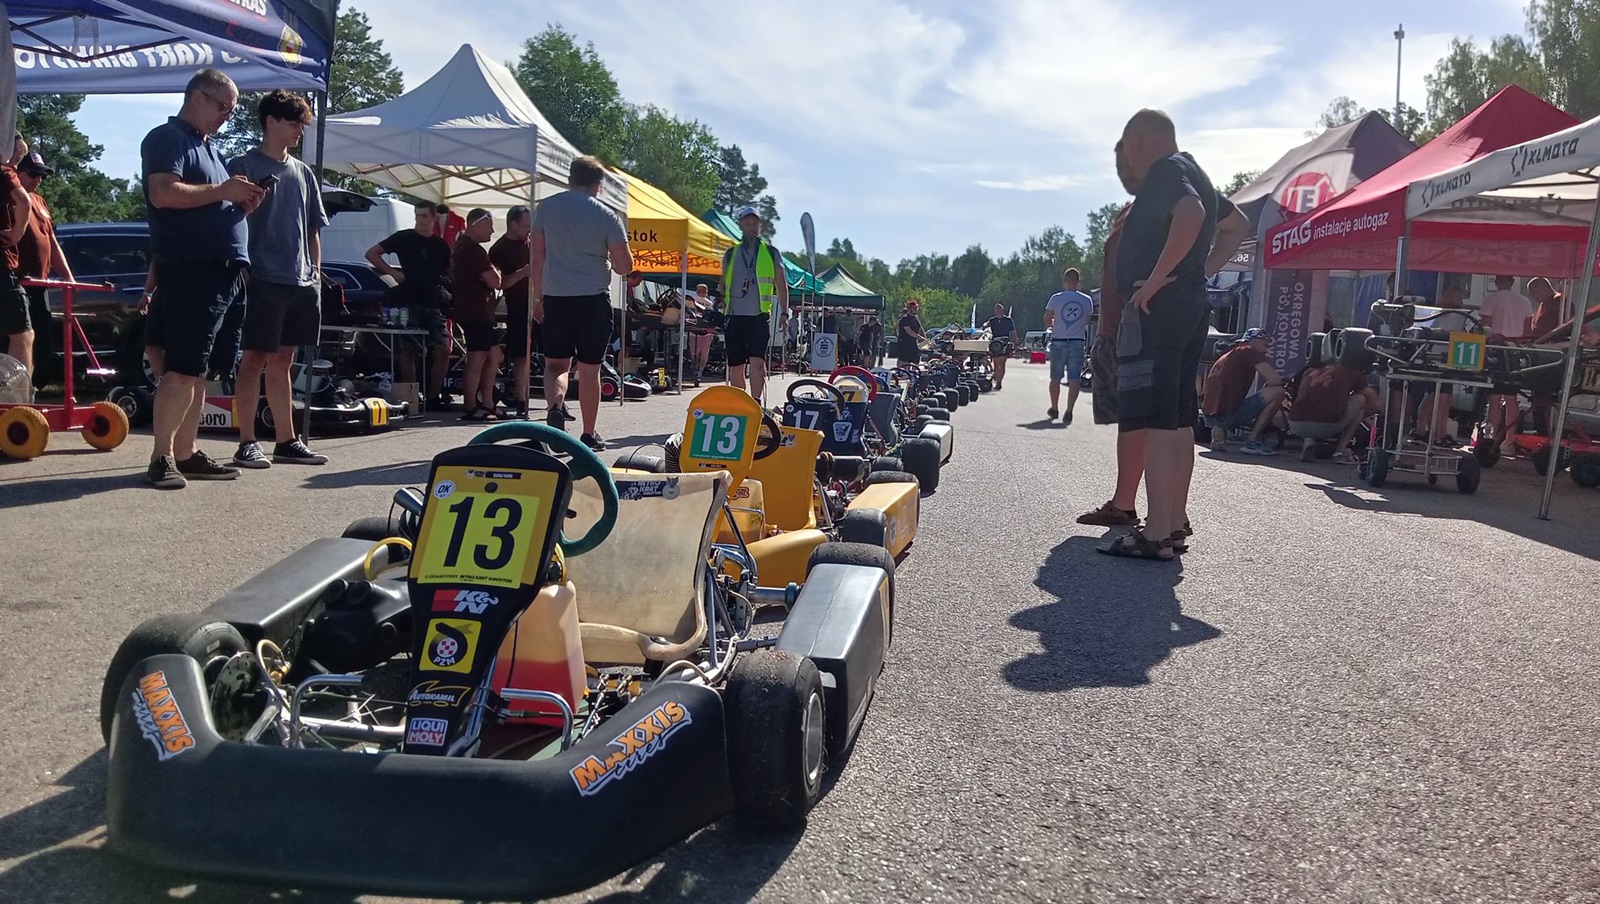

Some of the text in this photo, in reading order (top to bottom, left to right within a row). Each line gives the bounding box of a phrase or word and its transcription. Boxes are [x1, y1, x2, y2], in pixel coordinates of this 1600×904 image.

[1528, 138, 1579, 165] XLMOTO
[1434, 171, 1471, 197] XLMOTO
[1272, 212, 1389, 254] STAG instalacje autogaz
[1288, 282, 1305, 359] OKRĘGOWA
[1275, 311, 1289, 377] KONTROL
[1457, 342, 1477, 365] 11
[793, 409, 820, 430] 17
[702, 415, 740, 454] 13
[437, 484, 452, 494] OK
[443, 496, 523, 570] 13
[433, 656, 456, 666] PZM
[139, 671, 195, 753] MAXXIS
[410, 731, 443, 744] MOLY
[412, 720, 445, 733] LIQUI
[573, 701, 686, 790] MAXXIS
